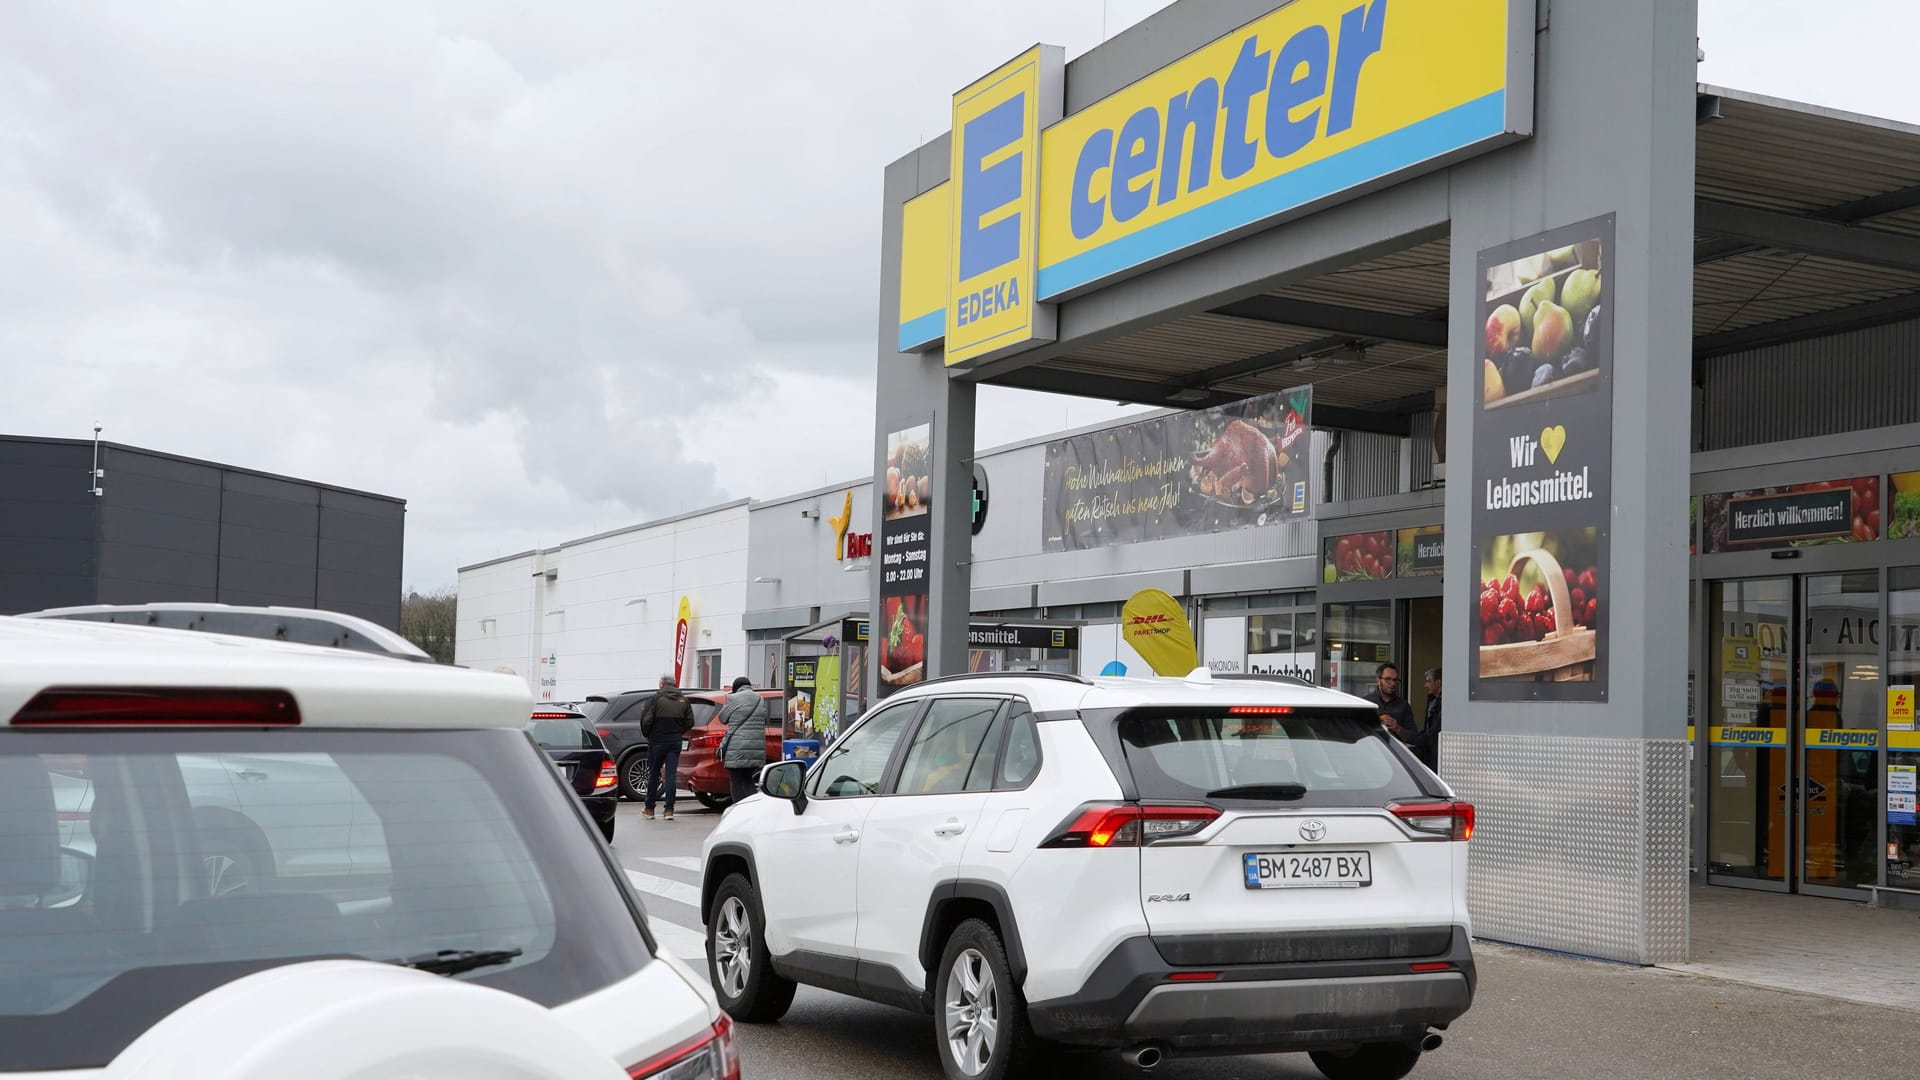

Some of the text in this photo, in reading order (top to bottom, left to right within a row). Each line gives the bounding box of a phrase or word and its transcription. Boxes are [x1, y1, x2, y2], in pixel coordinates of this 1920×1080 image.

[1070, 0, 1387, 240] center
[958, 91, 1025, 283] E
[957, 277, 1020, 327] EDEKA
[1510, 435, 1537, 468] Wir
[1065, 464, 1089, 490] Frohe
[1089, 456, 1144, 490] Weihnachten
[1144, 450, 1163, 479] und
[1486, 466, 1593, 510] Lebensmittel.
[1065, 499, 1091, 535] guten
[1091, 491, 1122, 523] Rutsch
[1735, 501, 1844, 529] Herzlich willkommen!
[886, 536, 894, 546] Wir
[884, 552, 902, 565] Montag
[905, 549, 927, 562] Samstag
[914, 568, 924, 579] Uhr
[1133, 614, 1168, 625] DHL
[1720, 727, 1774, 743] Eingang
[1819, 729, 1878, 746] Eingang
[1259, 857, 1363, 878] BM 2487 BX
